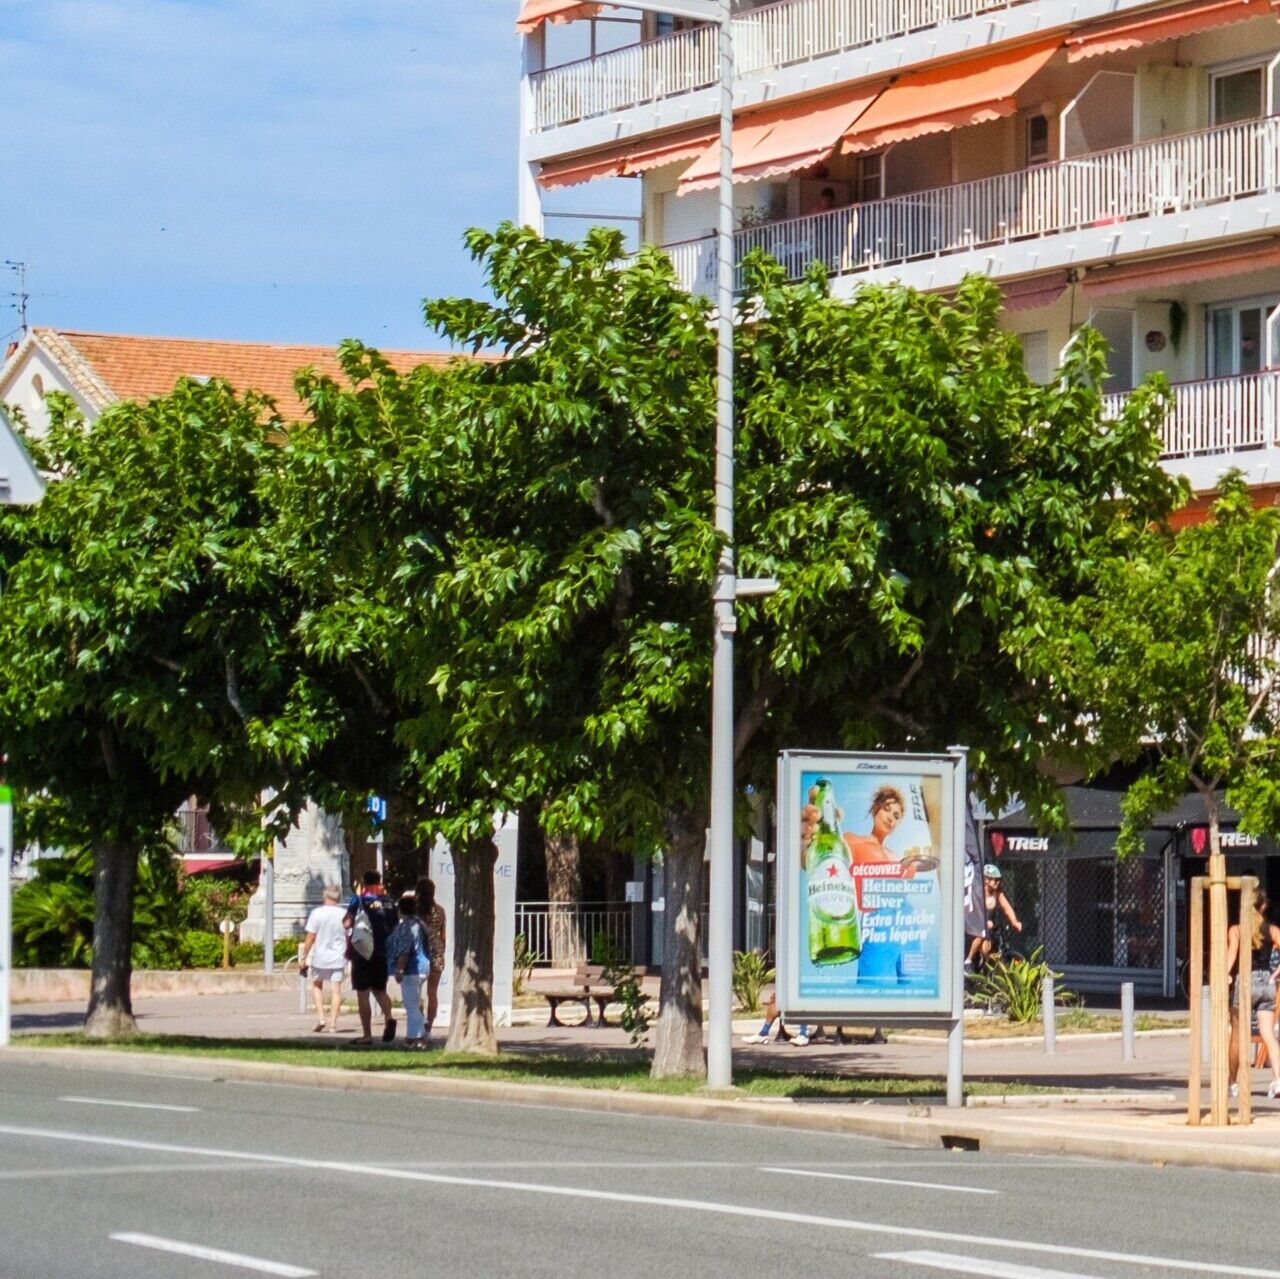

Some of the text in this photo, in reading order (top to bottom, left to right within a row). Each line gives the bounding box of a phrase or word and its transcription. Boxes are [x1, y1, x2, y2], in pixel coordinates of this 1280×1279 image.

[1007, 836, 1050, 851] TREK
[853, 863, 902, 876] DÉCOUVREZ
[863, 880, 929, 894] Heineken
[863, 895, 904, 908] Silver
[862, 912, 893, 928] Extra
[861, 928, 887, 944] Plus
